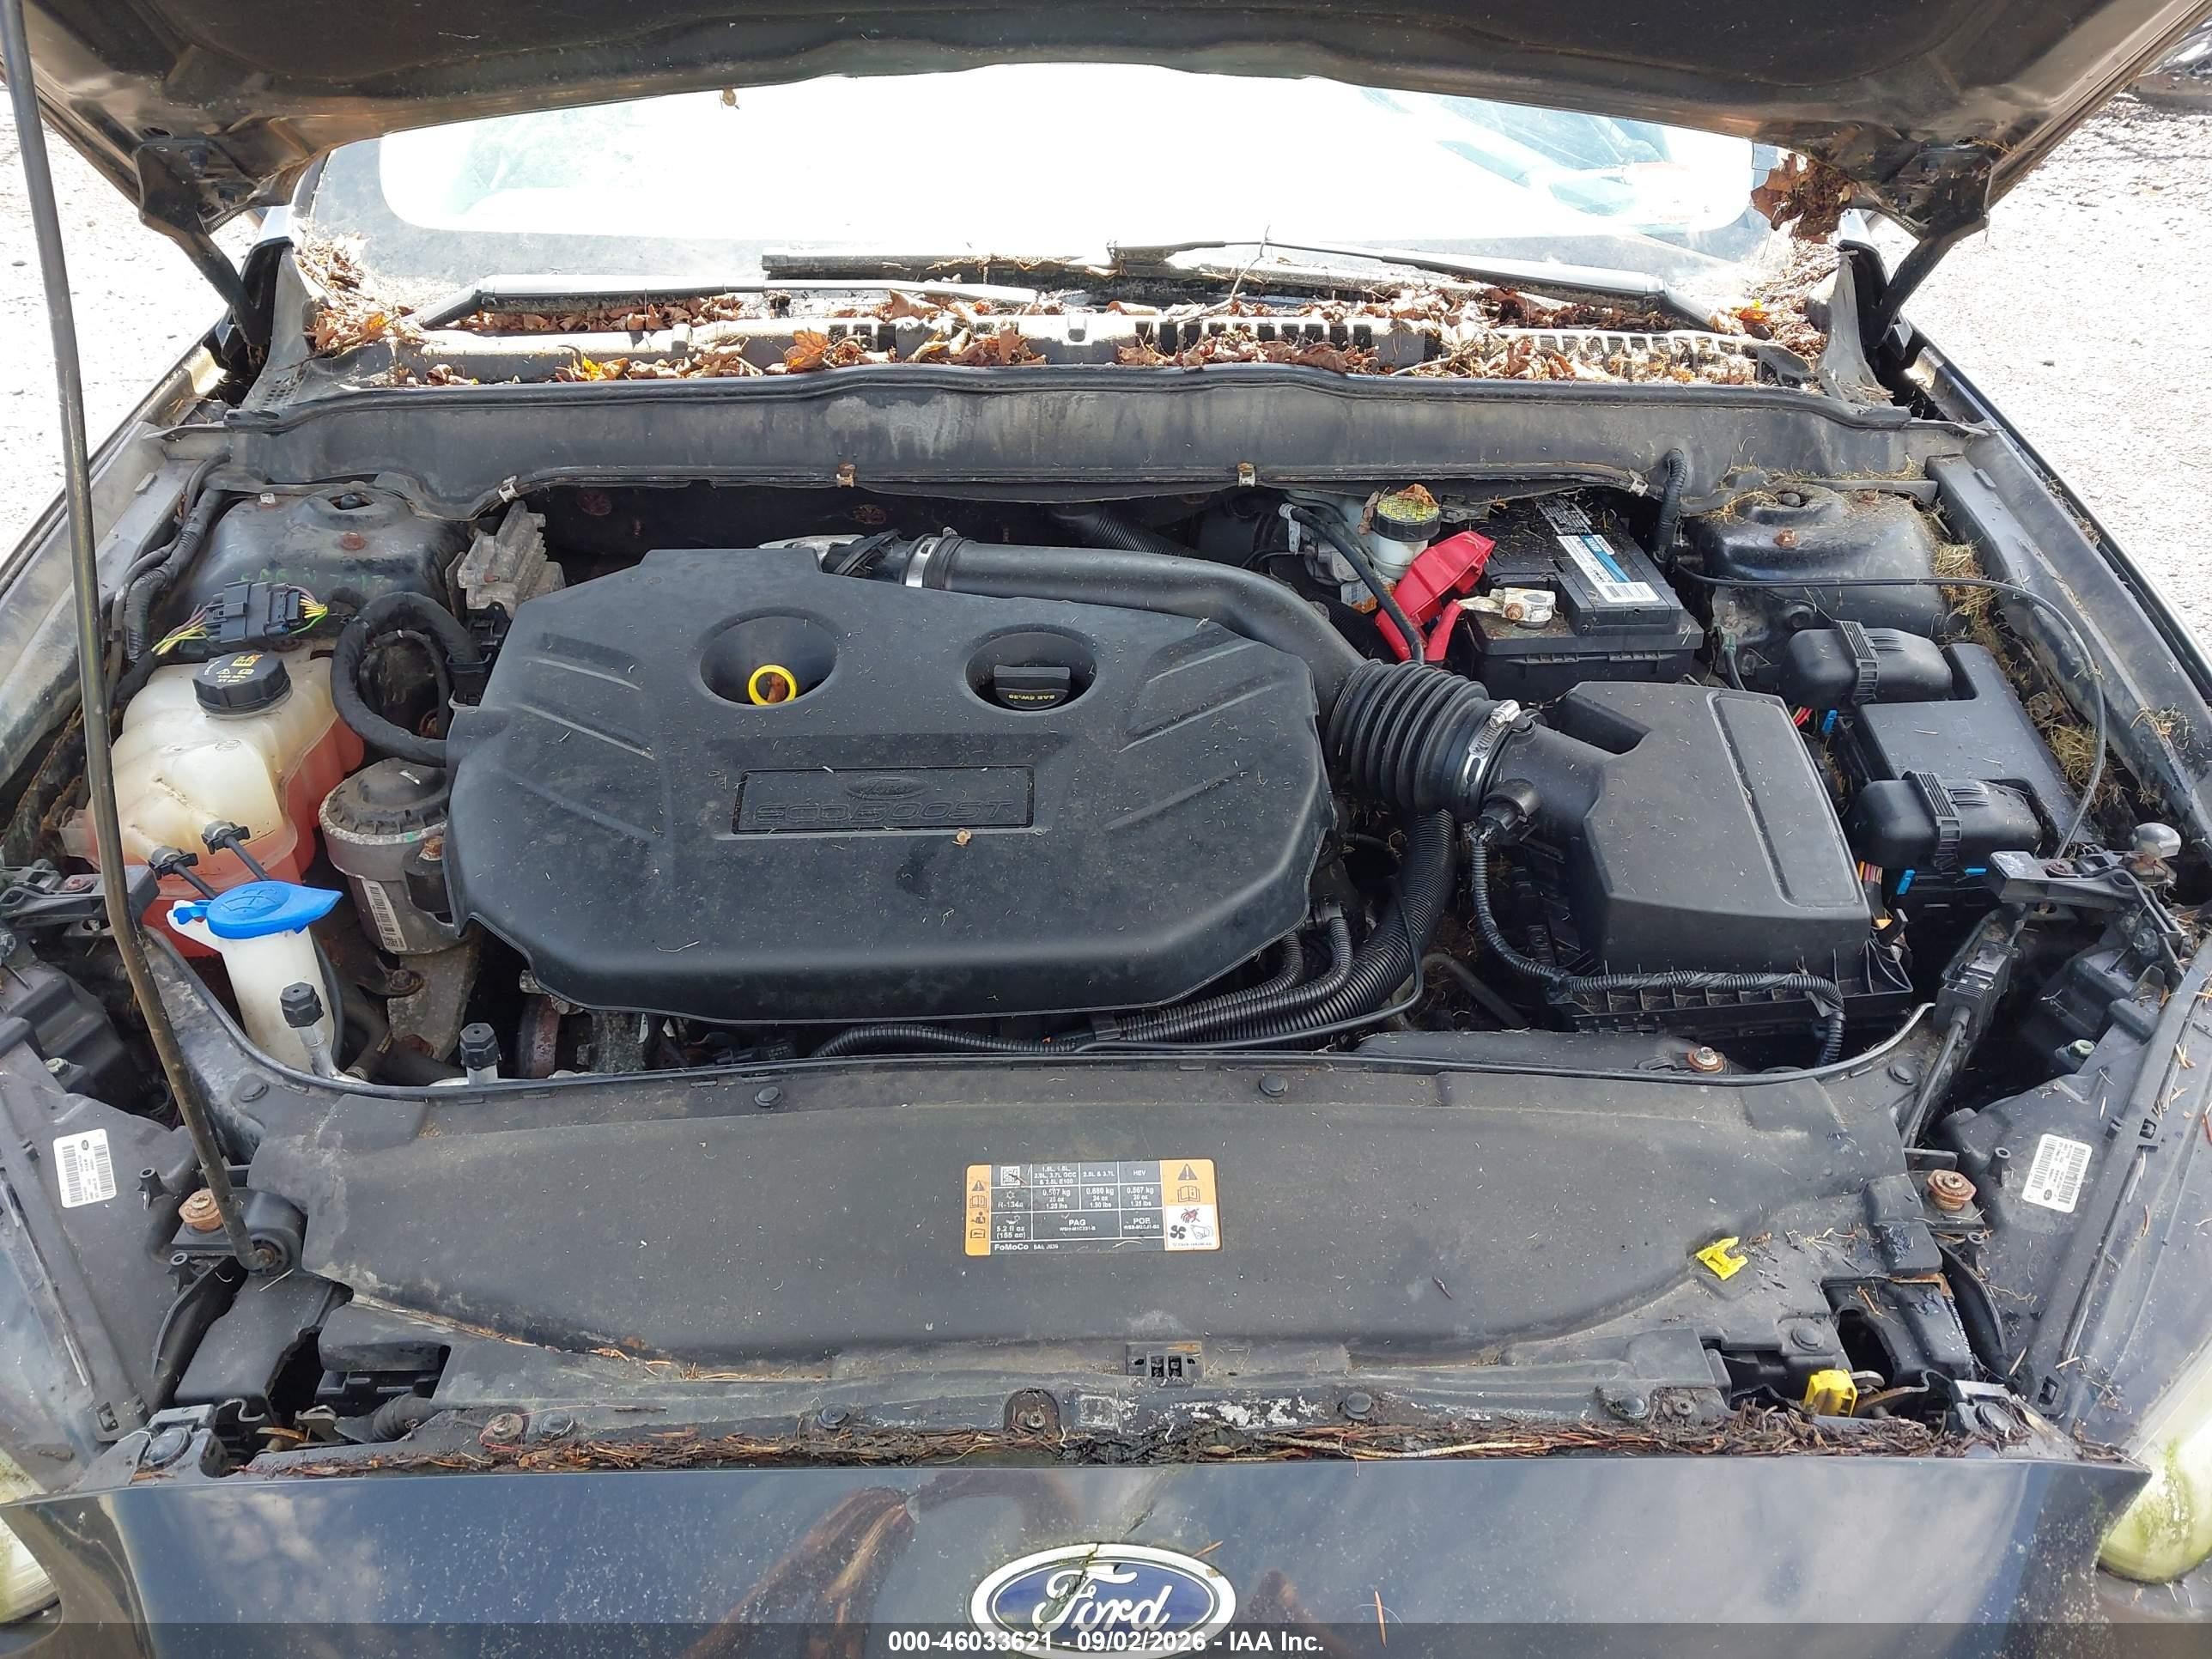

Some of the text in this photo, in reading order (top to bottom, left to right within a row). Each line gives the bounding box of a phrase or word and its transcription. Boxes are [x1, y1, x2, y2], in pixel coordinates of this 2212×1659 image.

[753, 800, 1013, 824] ECOBOOST
[1061, 1188, 1071, 1197] kg
[1105, 1187, 1115, 1196] kg
[1146, 1186, 1154, 1195] kg
[1032, 1569, 1174, 1632] Ford
